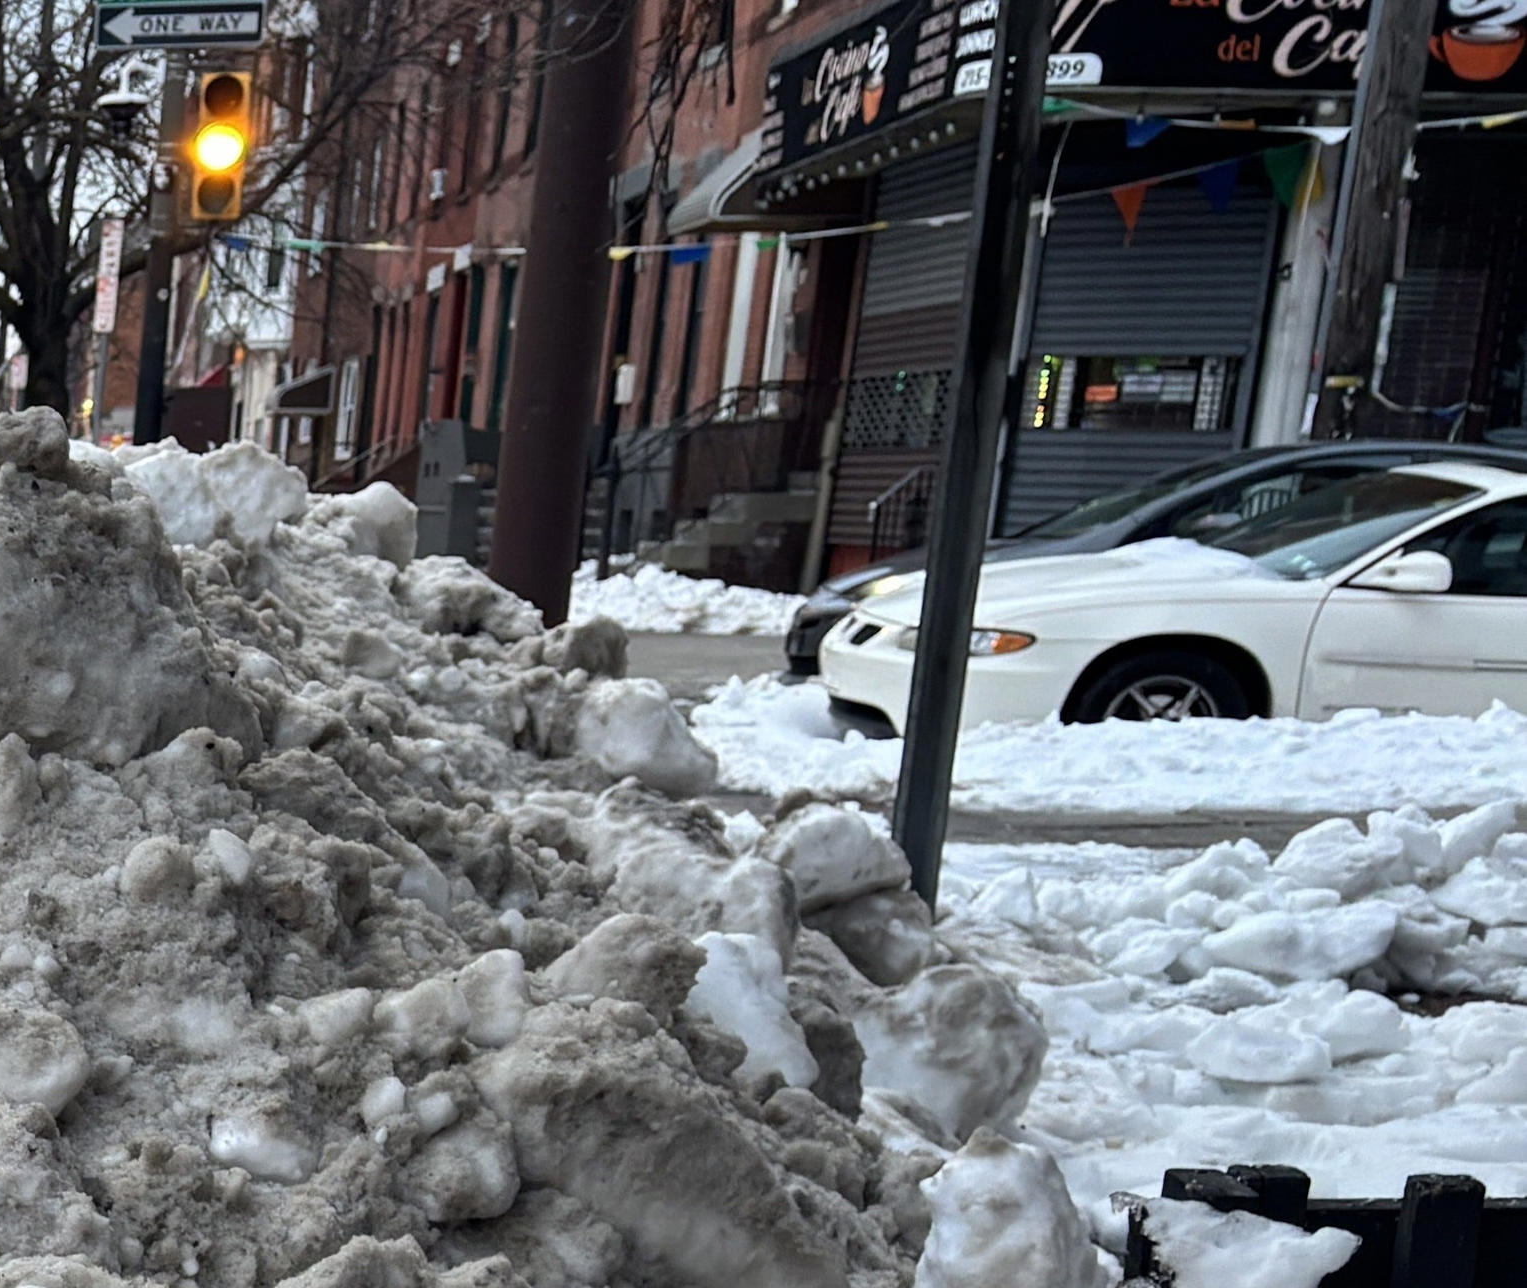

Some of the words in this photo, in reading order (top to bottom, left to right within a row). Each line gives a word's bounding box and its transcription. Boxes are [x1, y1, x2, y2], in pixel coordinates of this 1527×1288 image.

[140, 15, 185, 33] ONE
[199, 13, 245, 32] WAY
[1217, 33, 1261, 62] del
[1272, 14, 1368, 79] Ca
